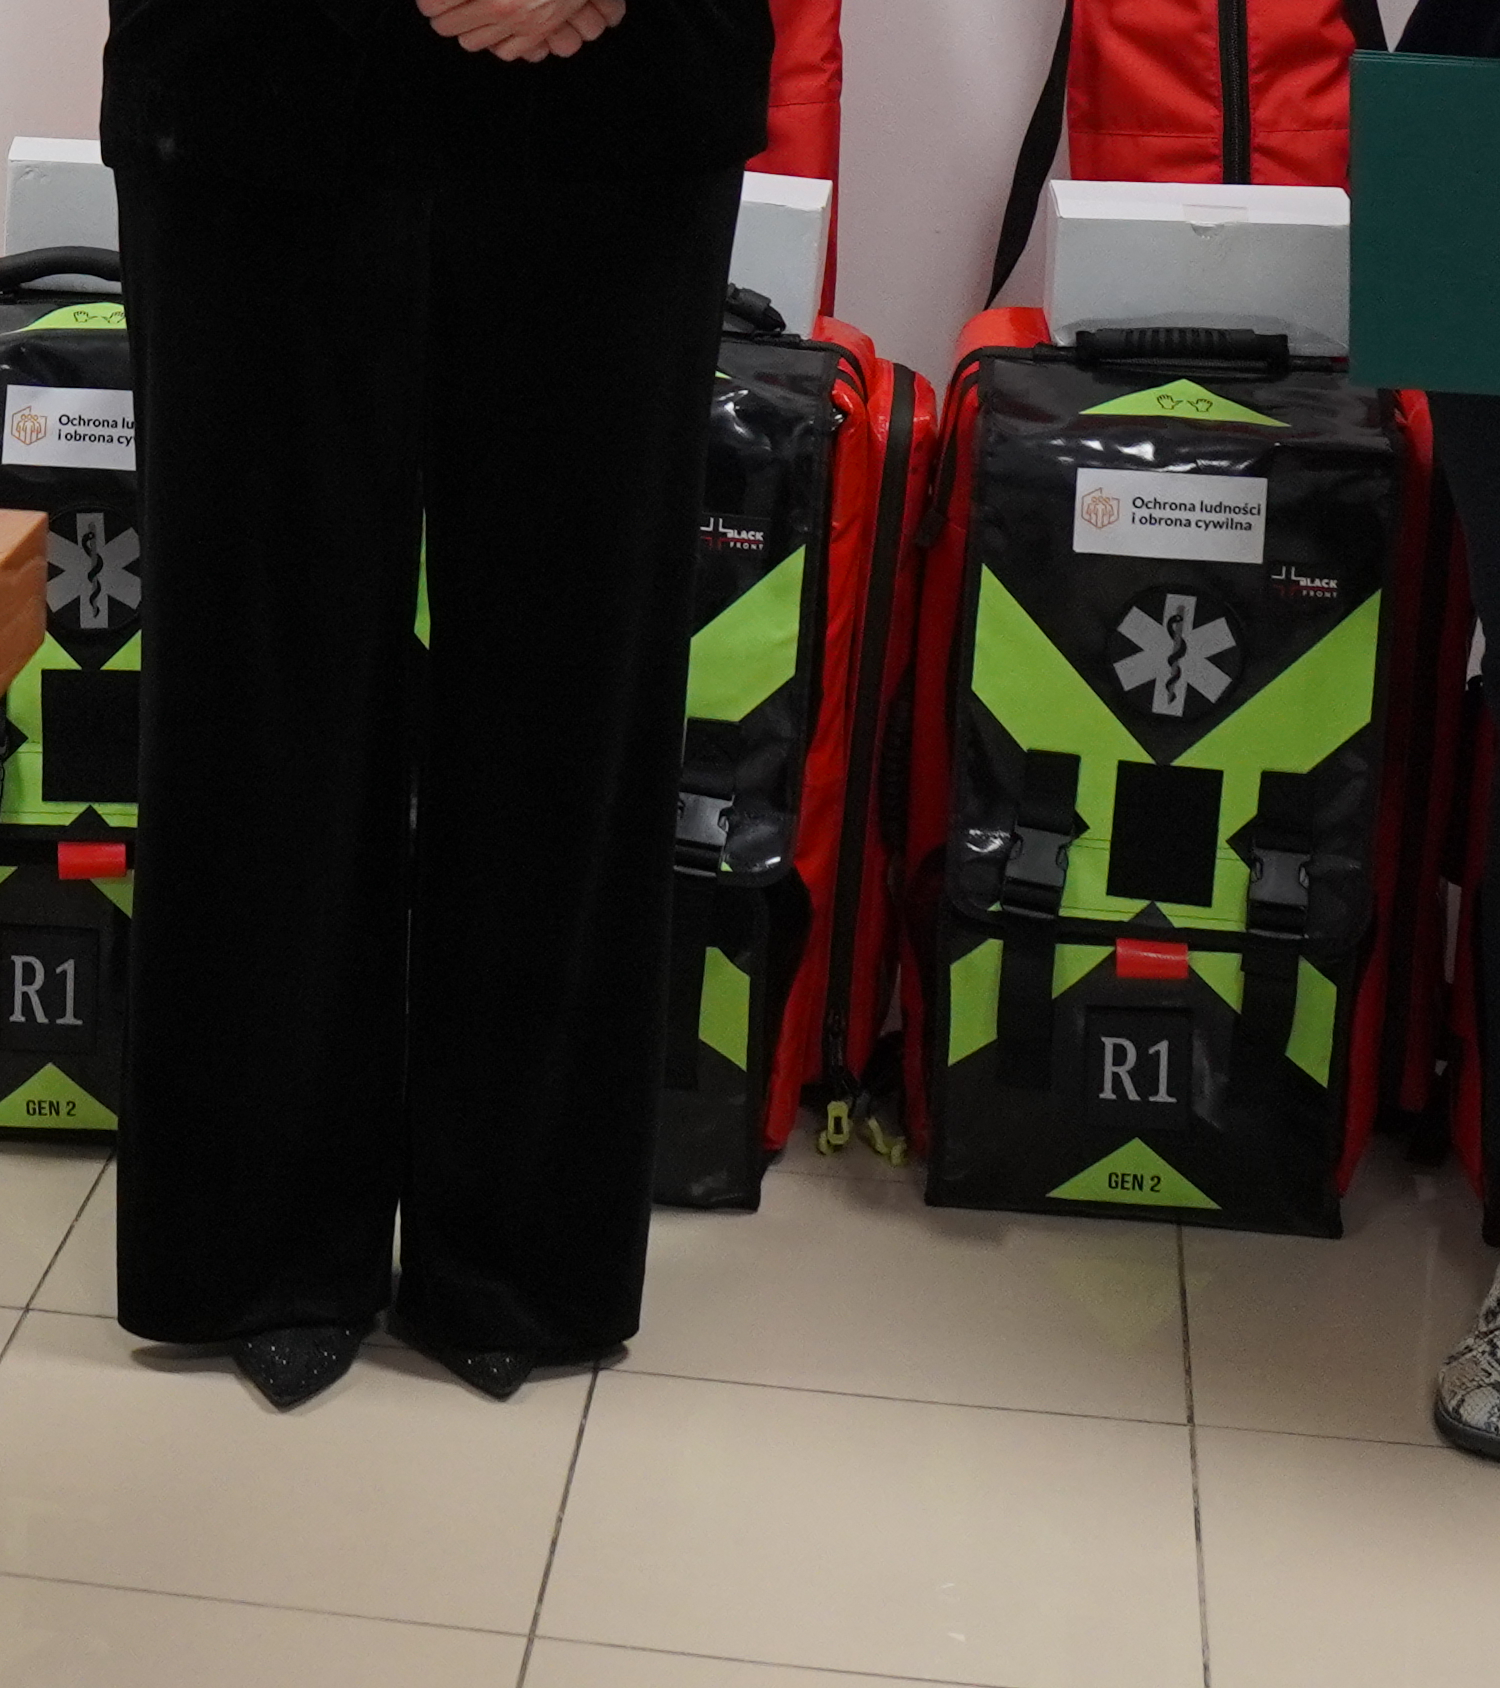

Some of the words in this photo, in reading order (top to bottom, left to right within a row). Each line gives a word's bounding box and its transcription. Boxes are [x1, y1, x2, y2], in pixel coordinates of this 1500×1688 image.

[58, 414, 118, 429] Ochrona
[57, 429, 61, 441] i
[65, 430, 114, 443] obrona
[1132, 496, 1196, 512] Ochrona
[1200, 500, 1262, 516] ludności
[1131, 513, 1135, 524] i
[1139, 514, 1191, 528] obrona
[1195, 517, 1252, 532] cywilna
[9, 955, 83, 1026] R1
[1099, 1036, 1178, 1103] R1
[26, 1100, 60, 1117] GEN
[66, 1101, 77, 1117] 2
[1108, 1172, 1144, 1191] GEN
[1150, 1176, 1161, 1192] 2
